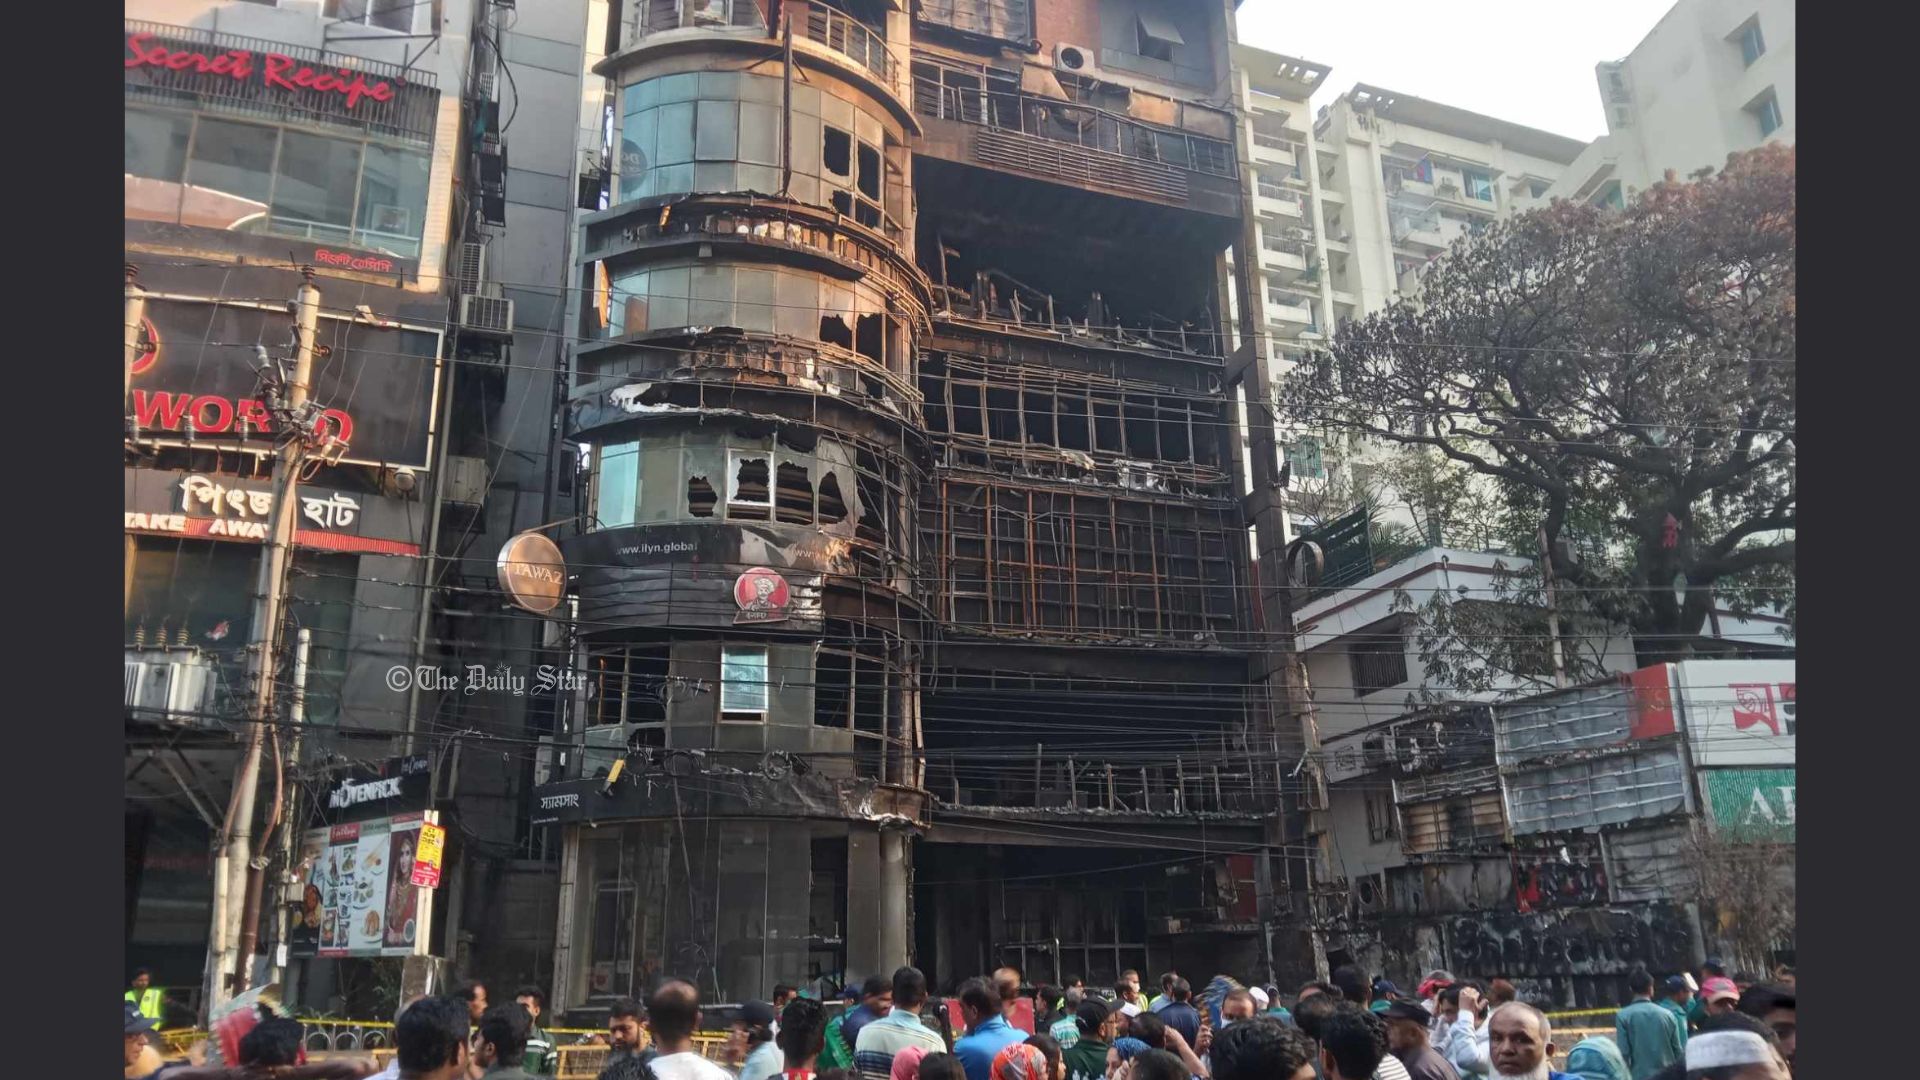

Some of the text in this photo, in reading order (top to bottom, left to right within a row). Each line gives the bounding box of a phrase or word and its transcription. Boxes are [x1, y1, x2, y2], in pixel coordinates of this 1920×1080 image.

[125, 31, 396, 109] Secret Recipe
[132, 388, 354, 444] WORD
[208, 517, 269, 539] AWA
[301, 491, 361, 530] হাট
